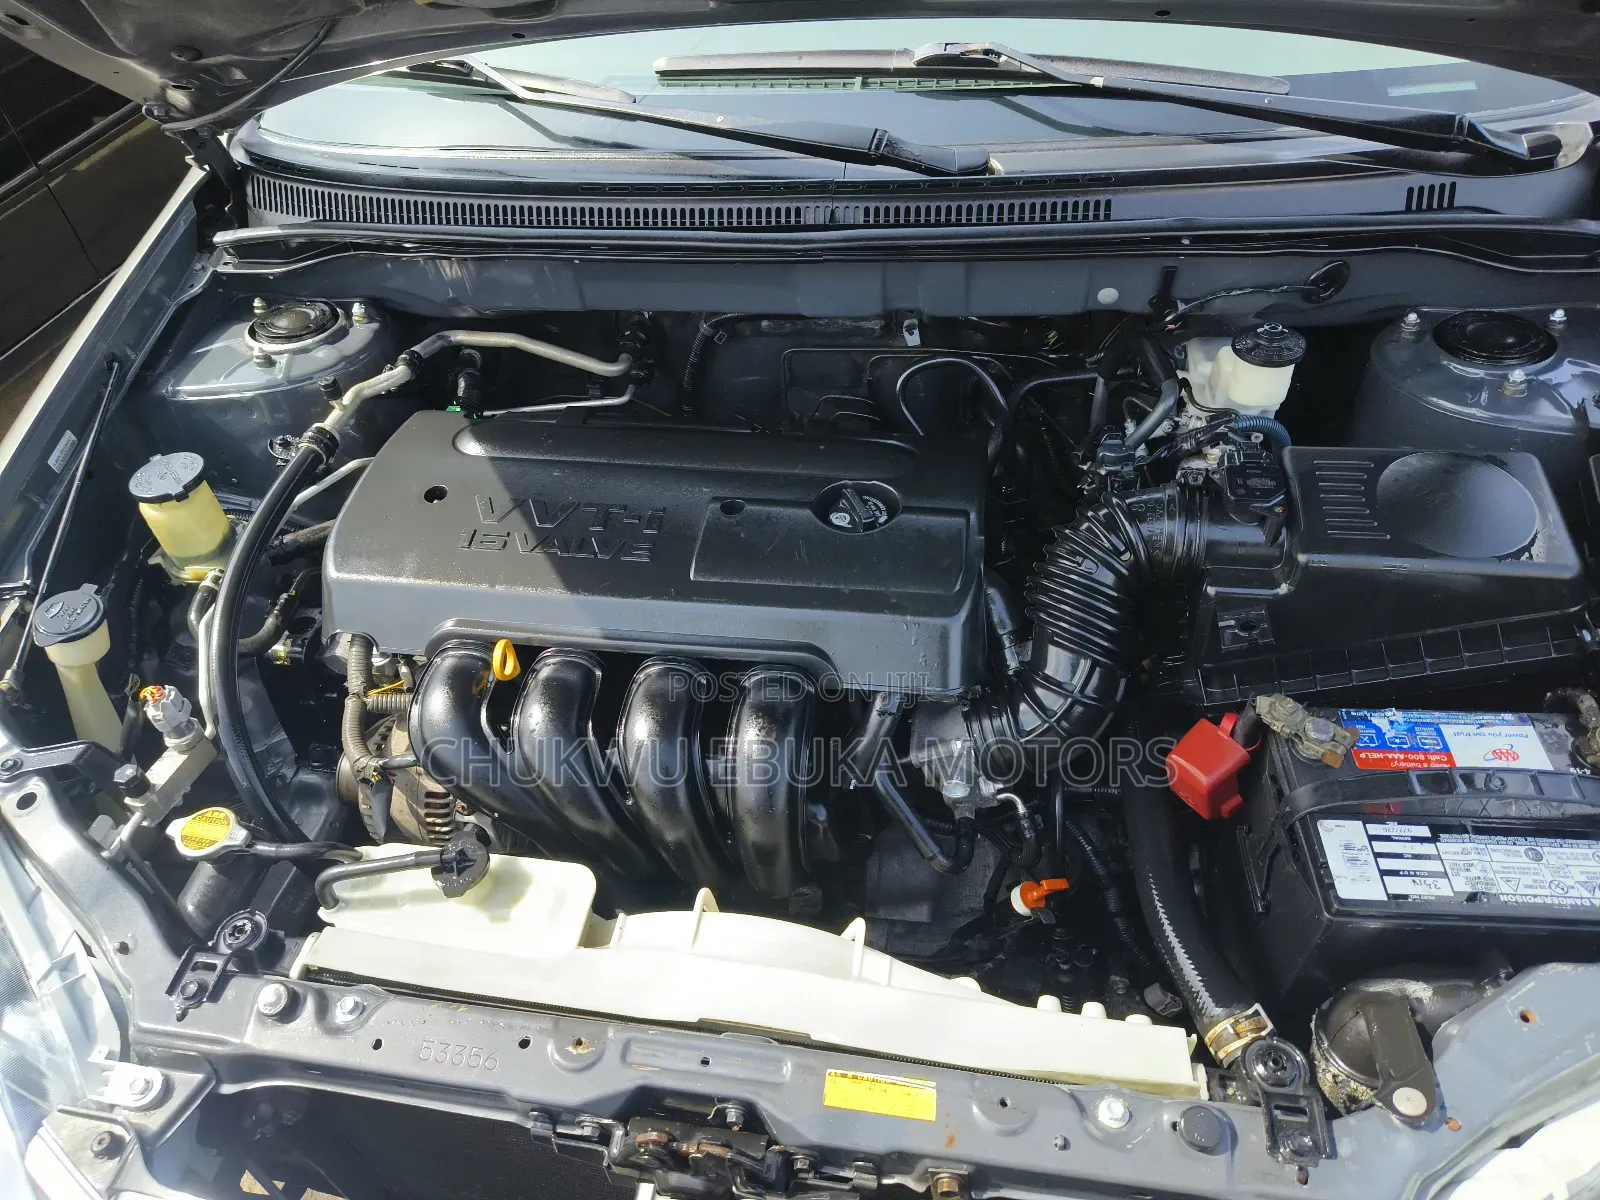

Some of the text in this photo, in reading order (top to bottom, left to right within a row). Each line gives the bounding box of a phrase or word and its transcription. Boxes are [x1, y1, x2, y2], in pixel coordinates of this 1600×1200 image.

[460, 528, 656, 562] 16 VALVE
[1492, 749, 1518, 761] AAA
[1499, 894, 1590, 906] DANGER/POISON
[419, 1039, 500, 1071] 53356
